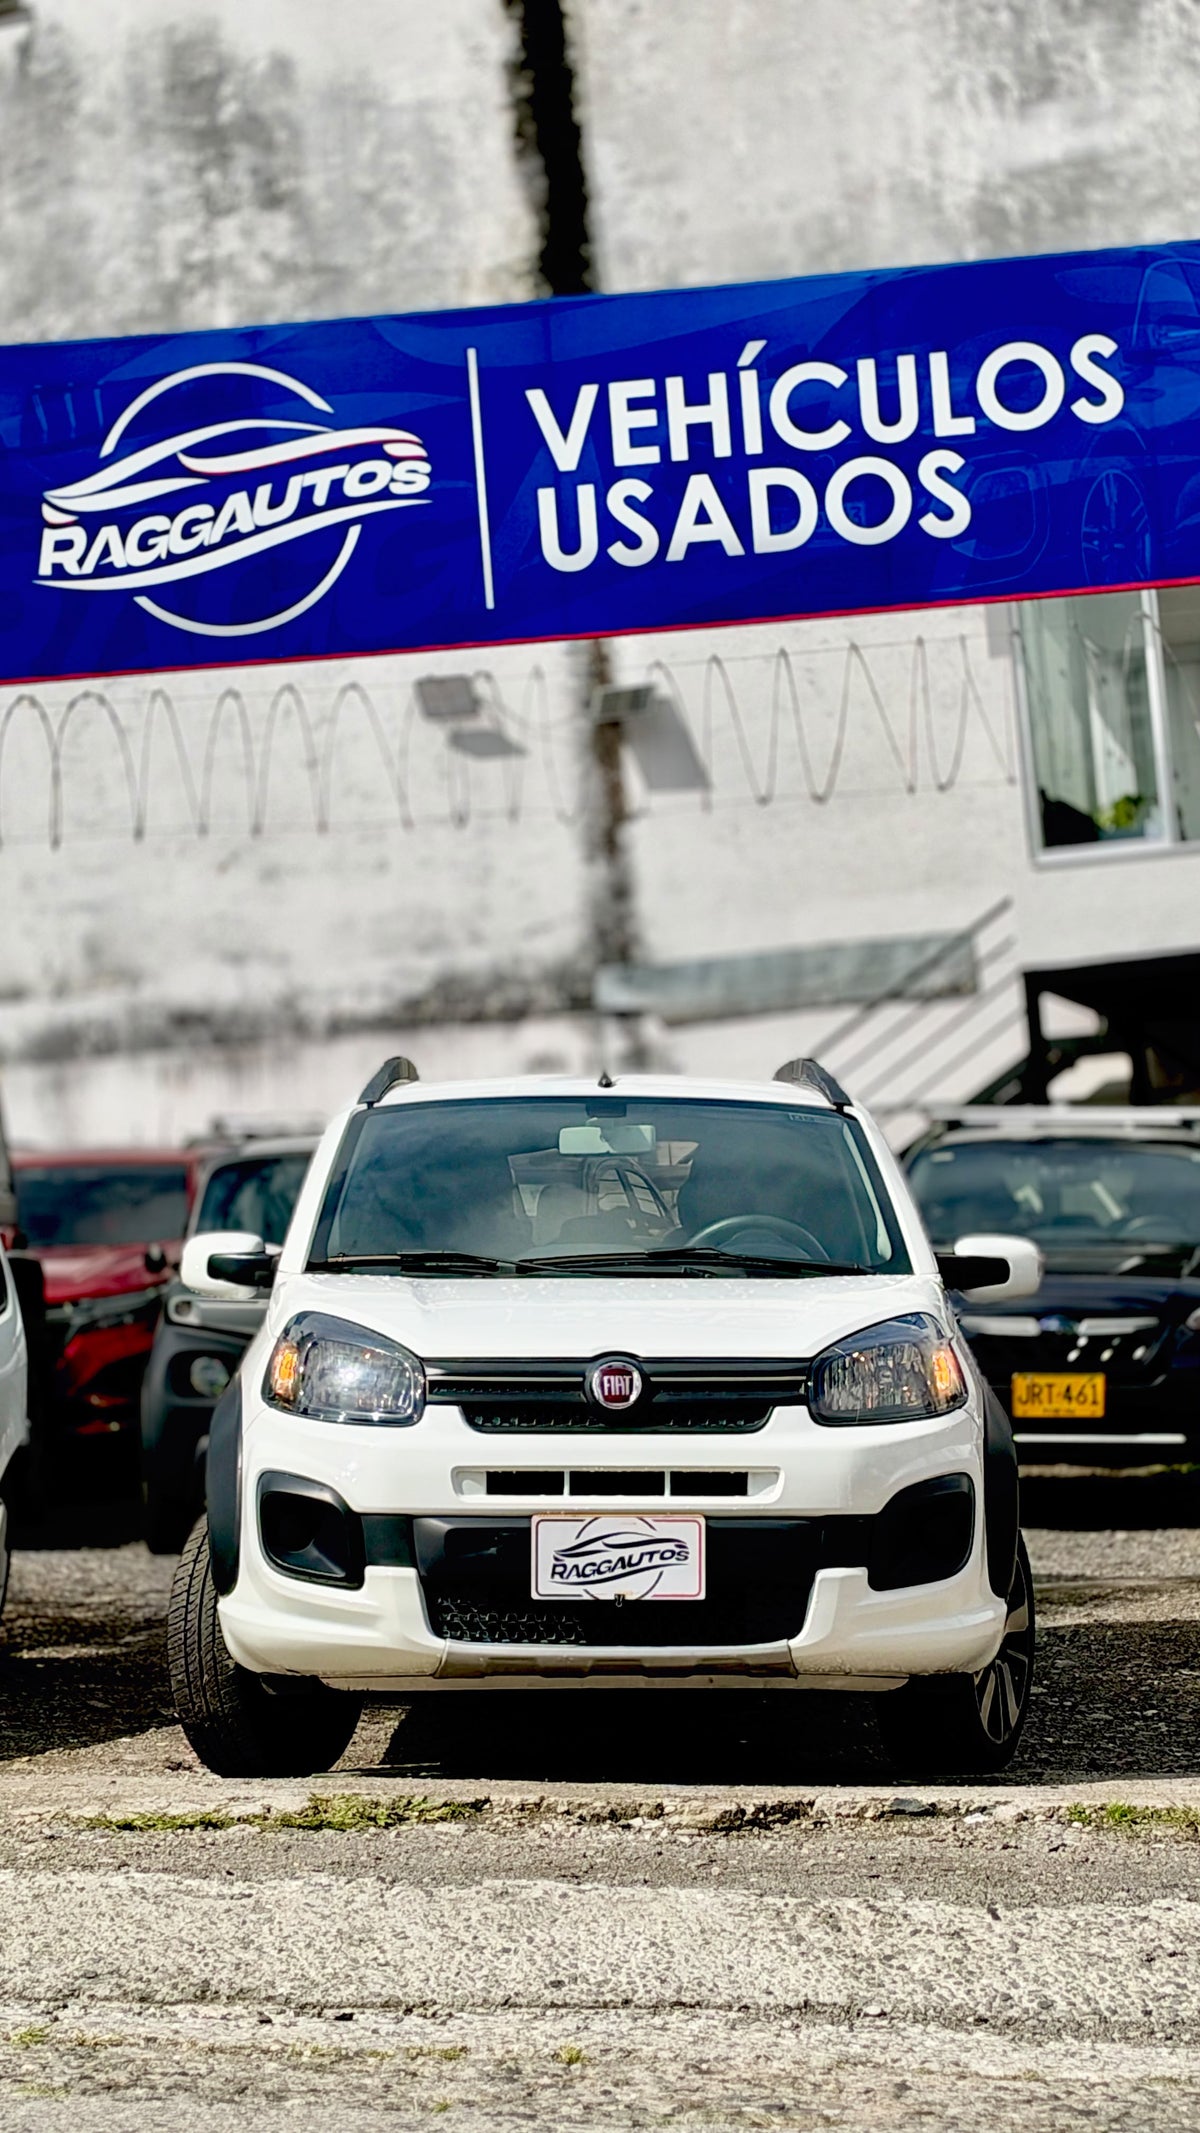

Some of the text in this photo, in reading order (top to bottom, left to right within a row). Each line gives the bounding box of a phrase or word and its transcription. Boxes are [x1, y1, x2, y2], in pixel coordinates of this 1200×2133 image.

[526, 334, 1124, 472] VEHÍCULOS
[39, 460, 432, 577] RAGGAUTOS
[538, 449, 972, 572] USADOS
[602, 1375, 632, 1396] FIAT
[550, 1549, 690, 1580] RAGGAUTOS
